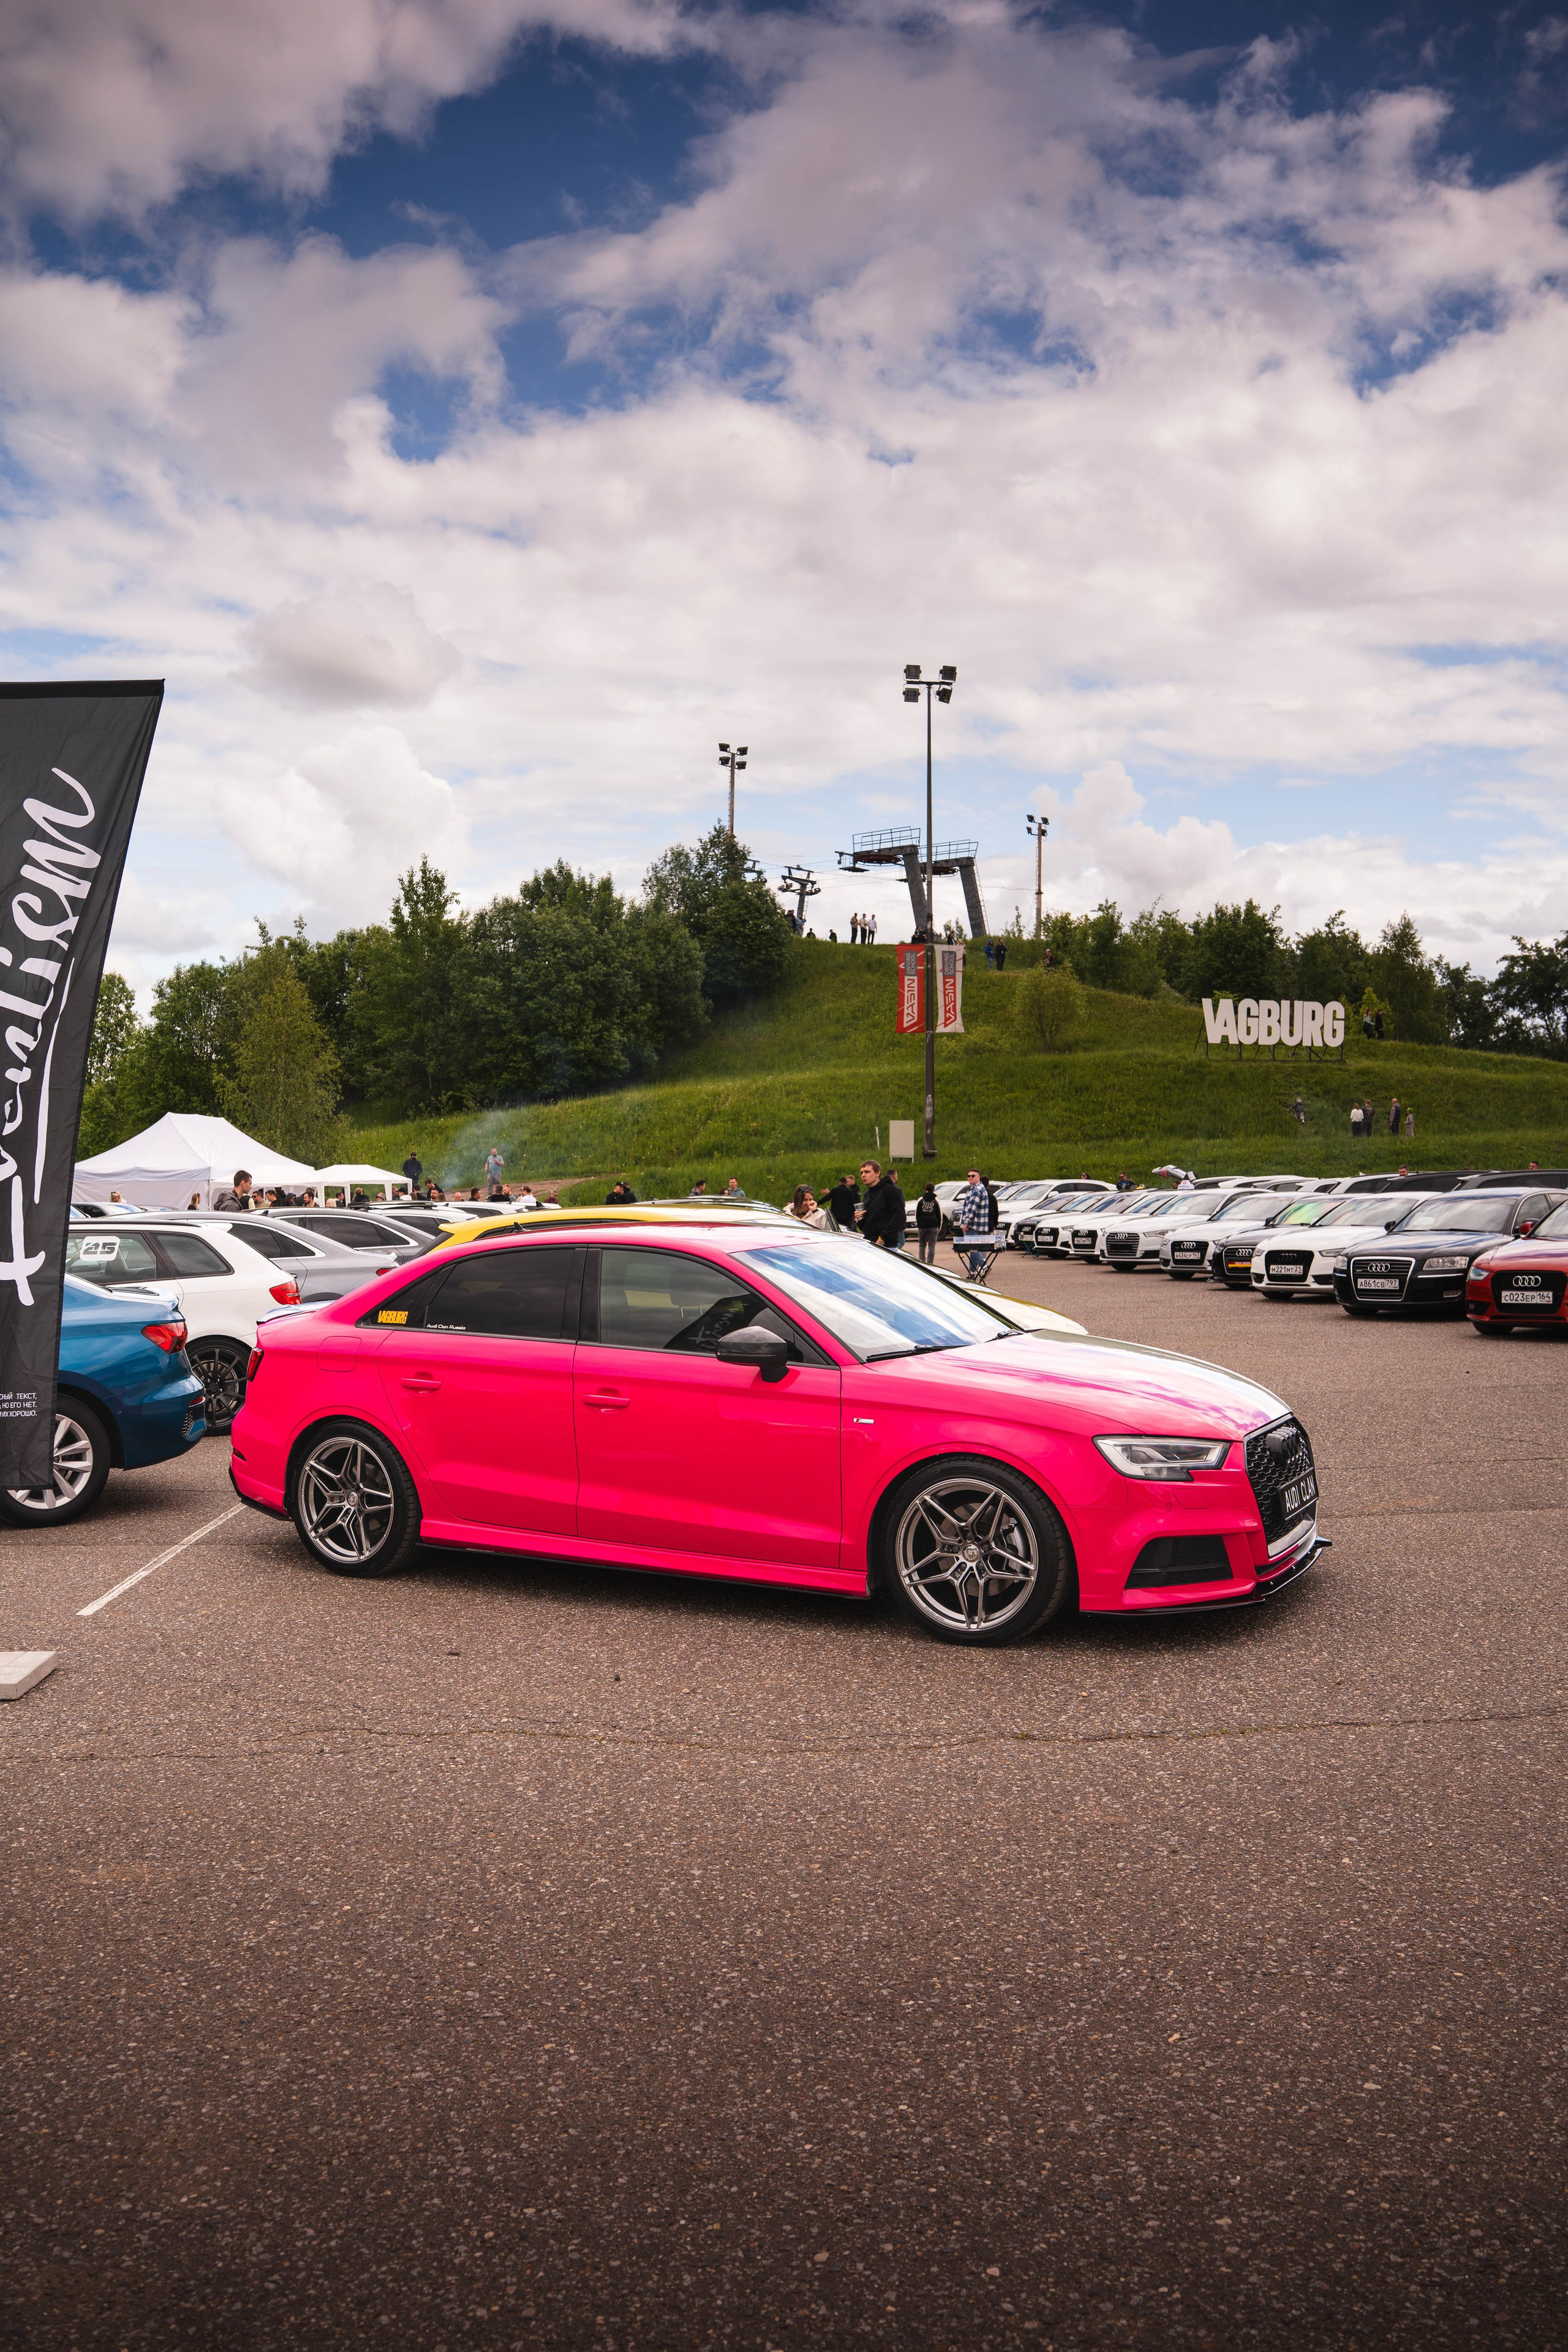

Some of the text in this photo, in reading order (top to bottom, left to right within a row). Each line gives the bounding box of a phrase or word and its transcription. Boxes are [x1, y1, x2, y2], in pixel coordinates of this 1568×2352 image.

[907, 979, 915, 1024] VASIN
[945, 979, 955, 1024] VASIN
[1202, 998, 1345, 1047] VAGBURG
[83, 1242, 117, 1255] 25
[1360, 1280, 1385, 1288] А861СВ
[1504, 1292, 1536, 1302] С023ЕР
[1285, 1475, 1316, 1513] AUDI CLAN
